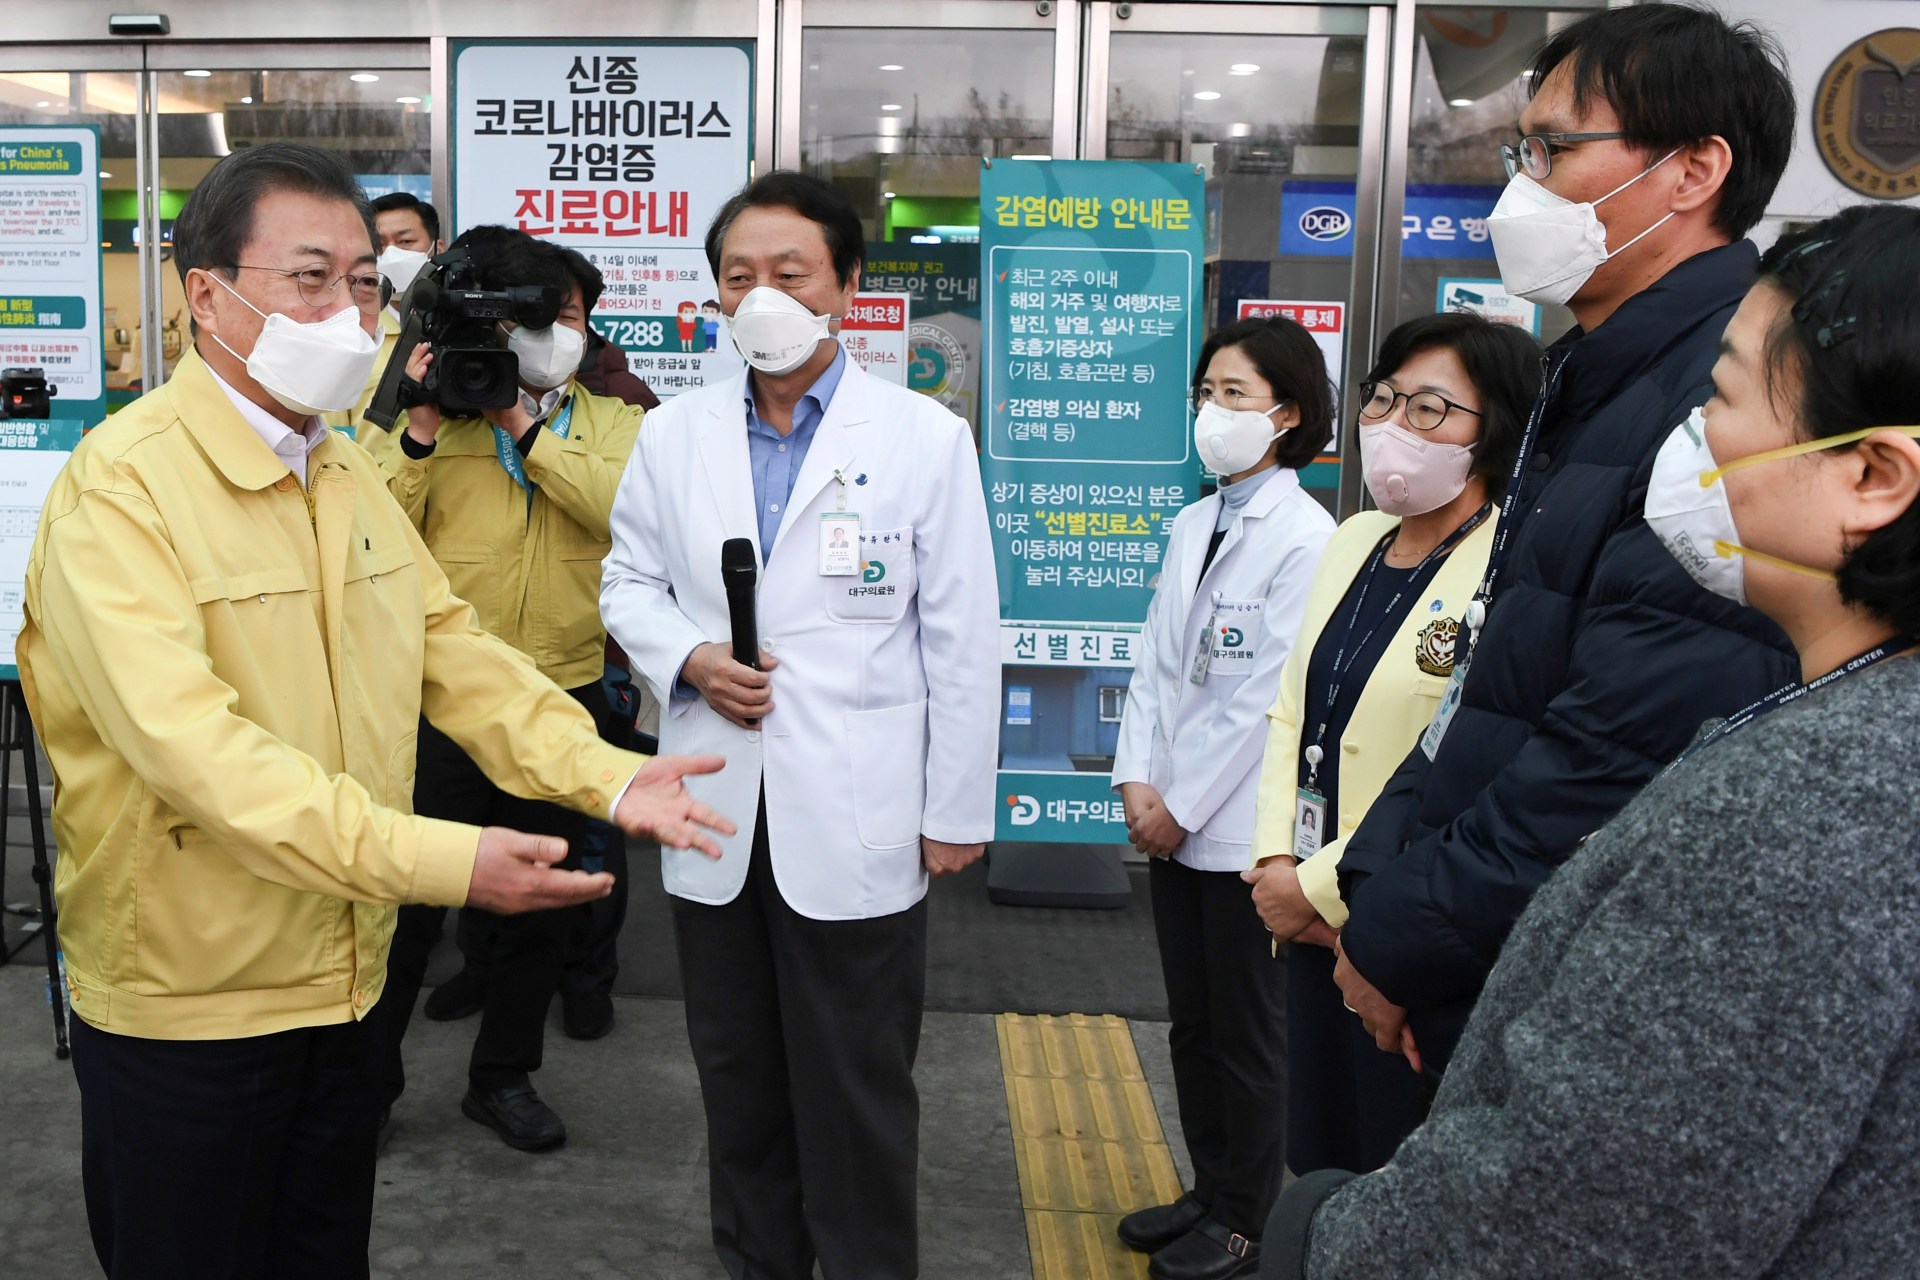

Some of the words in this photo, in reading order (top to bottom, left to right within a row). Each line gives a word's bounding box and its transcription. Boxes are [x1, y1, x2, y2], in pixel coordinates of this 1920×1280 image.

[566, 56, 638, 94] 신종
[474, 99, 731, 138] 코로나바이러스
[1, 147, 17, 158] for
[547, 143, 656, 182] 감염증
[10, 160, 69, 170] Pneumonia
[24, 190, 48, 198] strictly
[514, 189, 688, 237] 진료안내
[995, 195, 1101, 228] 감염예방
[1111, 198, 1191, 230] 안내문
[1305, 215, 1341, 231] DGB
[1401, 215, 1488, 242] 구은행
[603, 255, 624, 266] 14일
[628, 255, 658, 266] 이내에
[867, 261, 919, 273] 보건복지부
[924, 261, 944, 274] 권고
[632, 269, 661, 281] 인후통
[1011, 269, 1045, 287] 최근
[1050, 269, 1079, 288] 2주
[1084, 270, 1118, 289] 이내
[935, 277, 977, 301] 안내
[652, 299, 662, 310] 전
[1010, 292, 1045, 310] 해외
[1051, 292, 1086, 311] 거주
[1091, 293, 1107, 312] 및
[1114, 294, 1182, 313] 여행자로
[1010, 315, 1049, 334] 발진,
[1055, 316, 1093, 335] 발열,
[1100, 317, 1135, 336] 설사
[1139, 319, 1175, 336] 또는
[1301, 309, 1335, 328] 통제
[845, 337, 868, 350] 신종
[1009, 338, 1113, 358] 호흡기증상자
[634, 358, 654, 369] 받아
[657, 358, 688, 370] 응급실
[691, 358, 701, 370] 앞
[752, 350, 766, 360] 3M
[942, 336, 962, 373] CENTER
[1009, 361, 1052, 381] (기침,
[1057, 363, 1127, 382] 호흡곤란
[1131, 364, 1155, 384] 등)
[1009, 398, 1060, 418] 감염병
[1065, 400, 1100, 419] 의심
[1105, 400, 1142, 420] 환자
[39, 422, 49, 435] 및
[1008, 421, 1047, 441] (결핵
[1052, 422, 1076, 442] 등)
[499, 427, 516, 472] PRESIDEN
[1519, 434, 1529, 459] MEDICAL
[991, 483, 1024, 504] 상기
[1029, 484, 1083, 505] 증상이
[1089, 485, 1142, 507] 있으신
[1148, 486, 1185, 507] 분은
[996, 513, 1030, 534] 이곳
[1011, 539, 1082, 561] 이동하여
[1088, 541, 1161, 563] 인터폰을
[1678, 536, 1704, 568] N95
[1025, 565, 1061, 586] 눌러
[1066, 567, 1144, 588] 주십시오!
[849, 586, 896, 597] 대구의료원
[1213, 650, 1253, 659] 대구의료원
[1779, 685, 1808, 704] DAEGU
[1809, 668, 1846, 690] MEDICAL
[1847, 648, 1885, 672] CENTER
[1729, 700, 1763, 722] MEDICAL
[1764, 681, 1797, 702] CENTER
